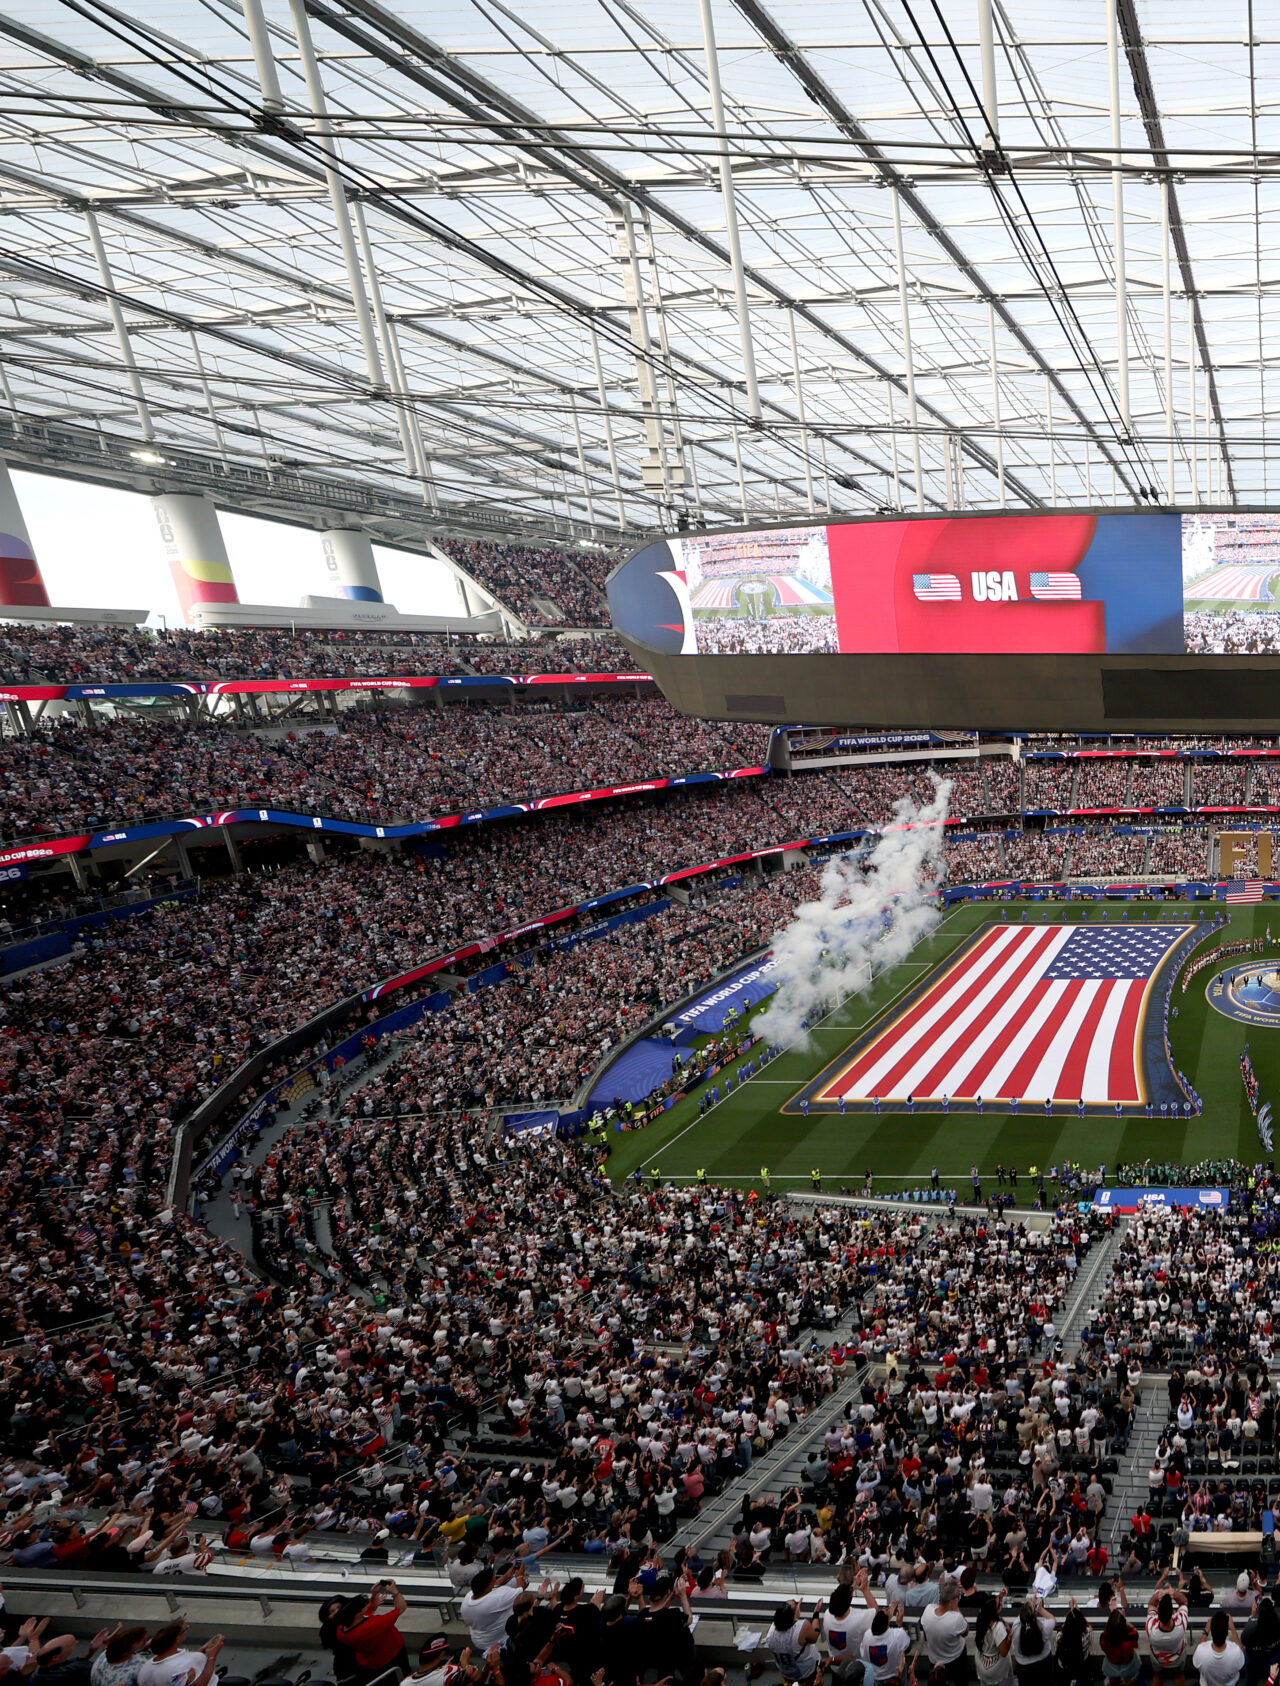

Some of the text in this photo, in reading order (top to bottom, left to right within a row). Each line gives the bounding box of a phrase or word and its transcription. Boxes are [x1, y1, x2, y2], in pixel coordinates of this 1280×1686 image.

[971, 570, 1019, 602] USA
[857, 737, 886, 745] WORLD
[903, 734, 930, 742] 2026
[114, 832, 127, 840] USA
[11, 851, 26, 860] CUP
[1212, 983, 1225, 997] FIFA
[678, 1004, 706, 1022] FIFA
[704, 983, 743, 1006] WORLD
[739, 972, 761, 984] CUP
[1233, 1010, 1252, 1020] FIFA
[723, 1052, 736, 1065] FIFA
[650, 1105, 665, 1119] FIFA
[1143, 1193, 1166, 1201] USA
